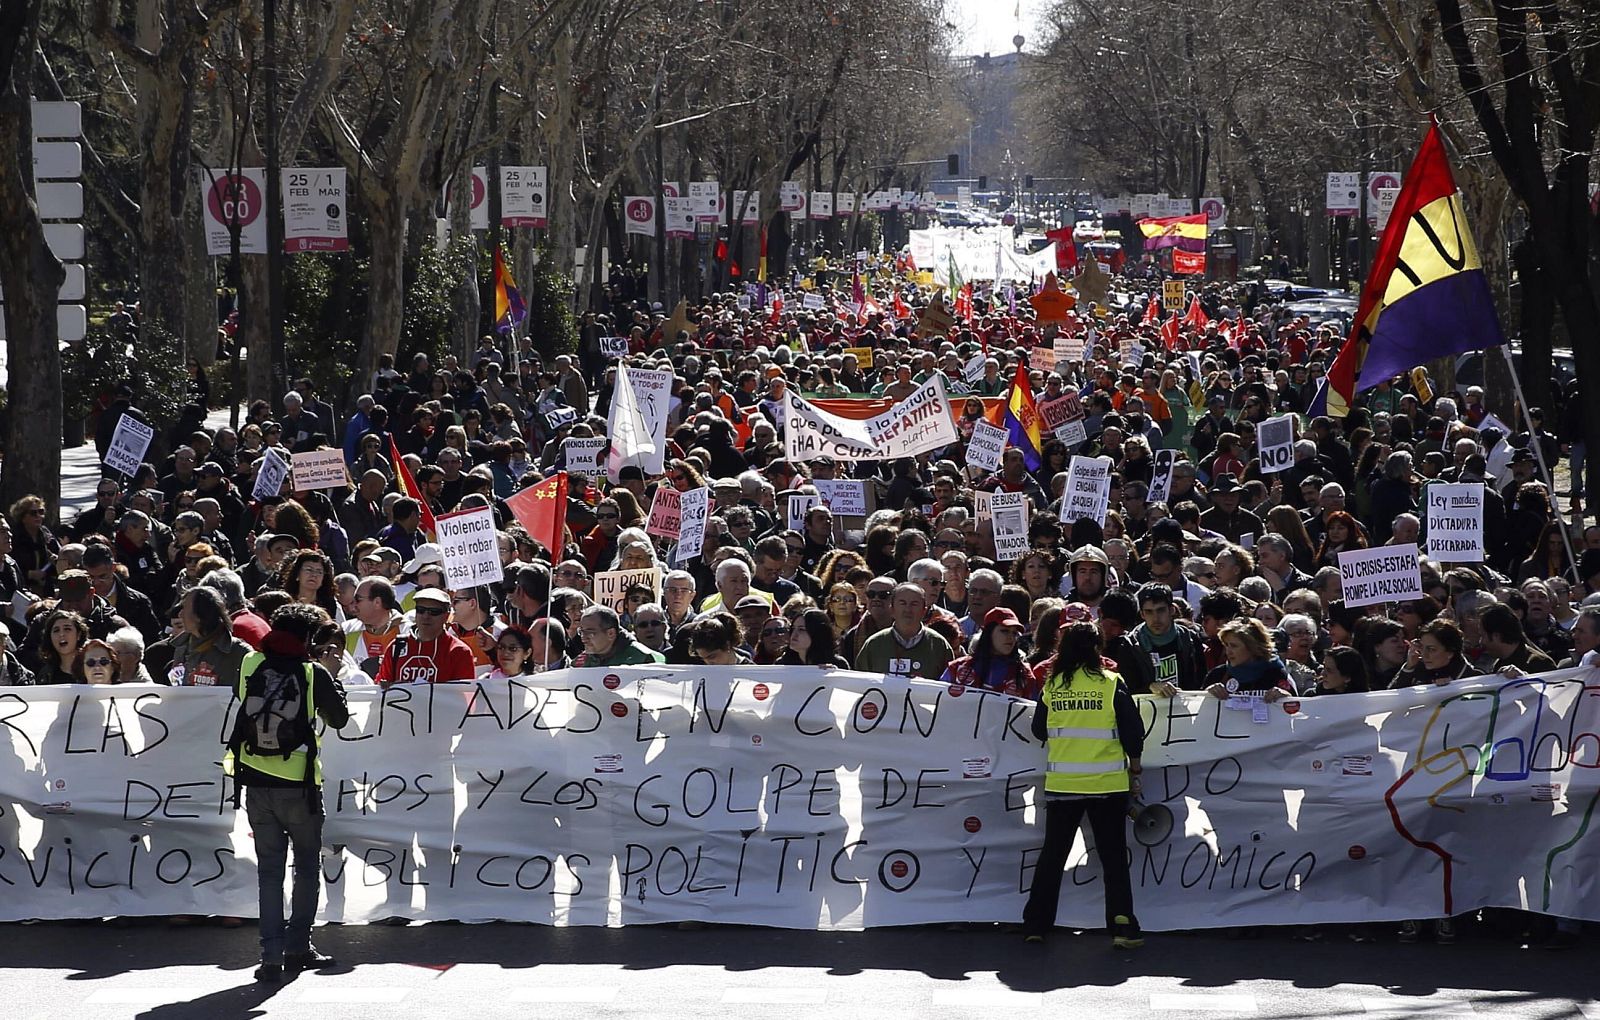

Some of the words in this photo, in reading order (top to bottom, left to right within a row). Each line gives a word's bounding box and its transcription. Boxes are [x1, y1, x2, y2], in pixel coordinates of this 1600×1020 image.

[289, 174, 308, 186] 25
[326, 174, 332, 186] 1
[506, 171, 520, 181] 25
[532, 171, 537, 180] 1
[289, 188, 310, 197] FEB
[318, 188, 341, 197] MAR
[1382, 192, 1393, 200] 25
[223, 200, 248, 219] CO
[1165, 296, 1184, 307] NO!
[892, 385, 937, 420] tortura
[121, 415, 131, 426] SE
[131, 419, 152, 437] BUSCA
[790, 417, 818, 430] que
[871, 398, 943, 447] HEPATITIS
[109, 447, 140, 468] TIMADOR
[833, 444, 891, 458] CURA!
[967, 448, 984, 463] REAL
[1261, 443, 1293, 468] NO!
[107, 458, 117, 466] en
[570, 457, 575, 465] y
[1074, 465, 1089, 478] Golpe
[1075, 480, 1098, 494] ENGAÑA
[977, 497, 987, 512] LA
[991, 495, 1000, 506] SE
[1000, 493, 1022, 505] BUSCA
[1071, 495, 1093, 508] SAQUEA
[1430, 491, 1448, 511] Ley
[441, 516, 491, 537] Violencia
[1430, 514, 1478, 531] DICTADURA
[444, 545, 456, 558] es
[457, 541, 467, 556] el
[468, 538, 493, 555] robar
[996, 537, 1027, 550] TIMADOR
[1430, 538, 1481, 552] DESCARADA.
[998, 551, 1008, 560] en
[447, 565, 469, 579] casa
[470, 563, 477, 579] y
[478, 560, 498, 577] pan.
[1342, 563, 1354, 580] SU
[1355, 554, 1418, 578] CRISIS-ESTAFA
[598, 577, 615, 593] TU
[1344, 583, 1369, 602] ROMPE
[1369, 582, 1379, 597] LA
[1379, 579, 1393, 595] PAZ
[402, 666, 435, 681] STOP
[1051, 690, 1104, 699] Bomberos
[1051, 699, 1103, 712] QUEMADOS
[65, 695, 169, 757] LAS
[220, 679, 601, 746] LERTADES
[635, 673, 741, 743] EN
[794, 686, 1046, 750] CONTR
[1136, 694, 1250, 747] DEL
[477, 769, 504, 810] Y
[520, 770, 603, 811] LOS
[633, 763, 834, 827] GOLPE
[876, 768, 950, 810] DE
[1005, 756, 1242, 812] EDO
[962, 846, 986, 898] Y
